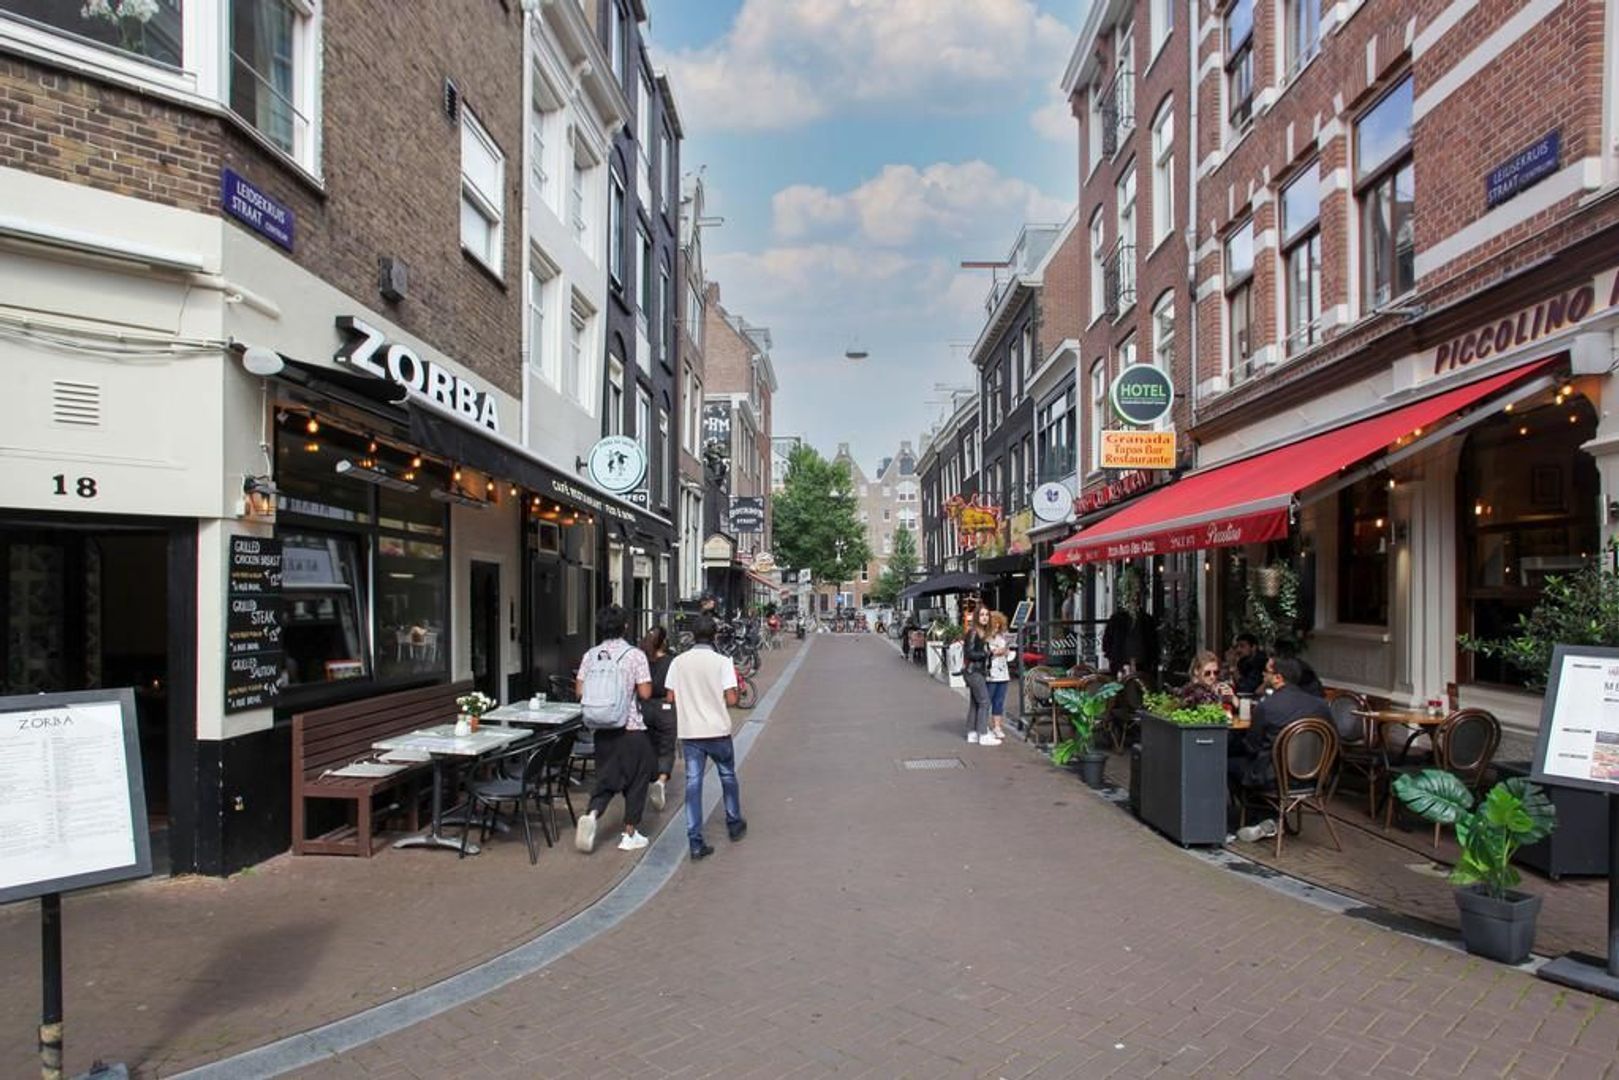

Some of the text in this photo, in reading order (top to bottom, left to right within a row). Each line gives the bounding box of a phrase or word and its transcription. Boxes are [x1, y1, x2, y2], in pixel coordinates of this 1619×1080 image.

[232, 195, 263, 225] STRAAT
[1434, 286, 1595, 375] PICCOLINO
[346, 316, 499, 431] ZORBA
[1120, 383, 1167, 397] HOTEL
[1106, 434, 1171, 445] Granada
[1105, 454, 1172, 465] Restaurante
[52, 474, 97, 498] 18
[251, 610, 277, 625] STEAK
[19, 715, 74, 730] ZORBA
